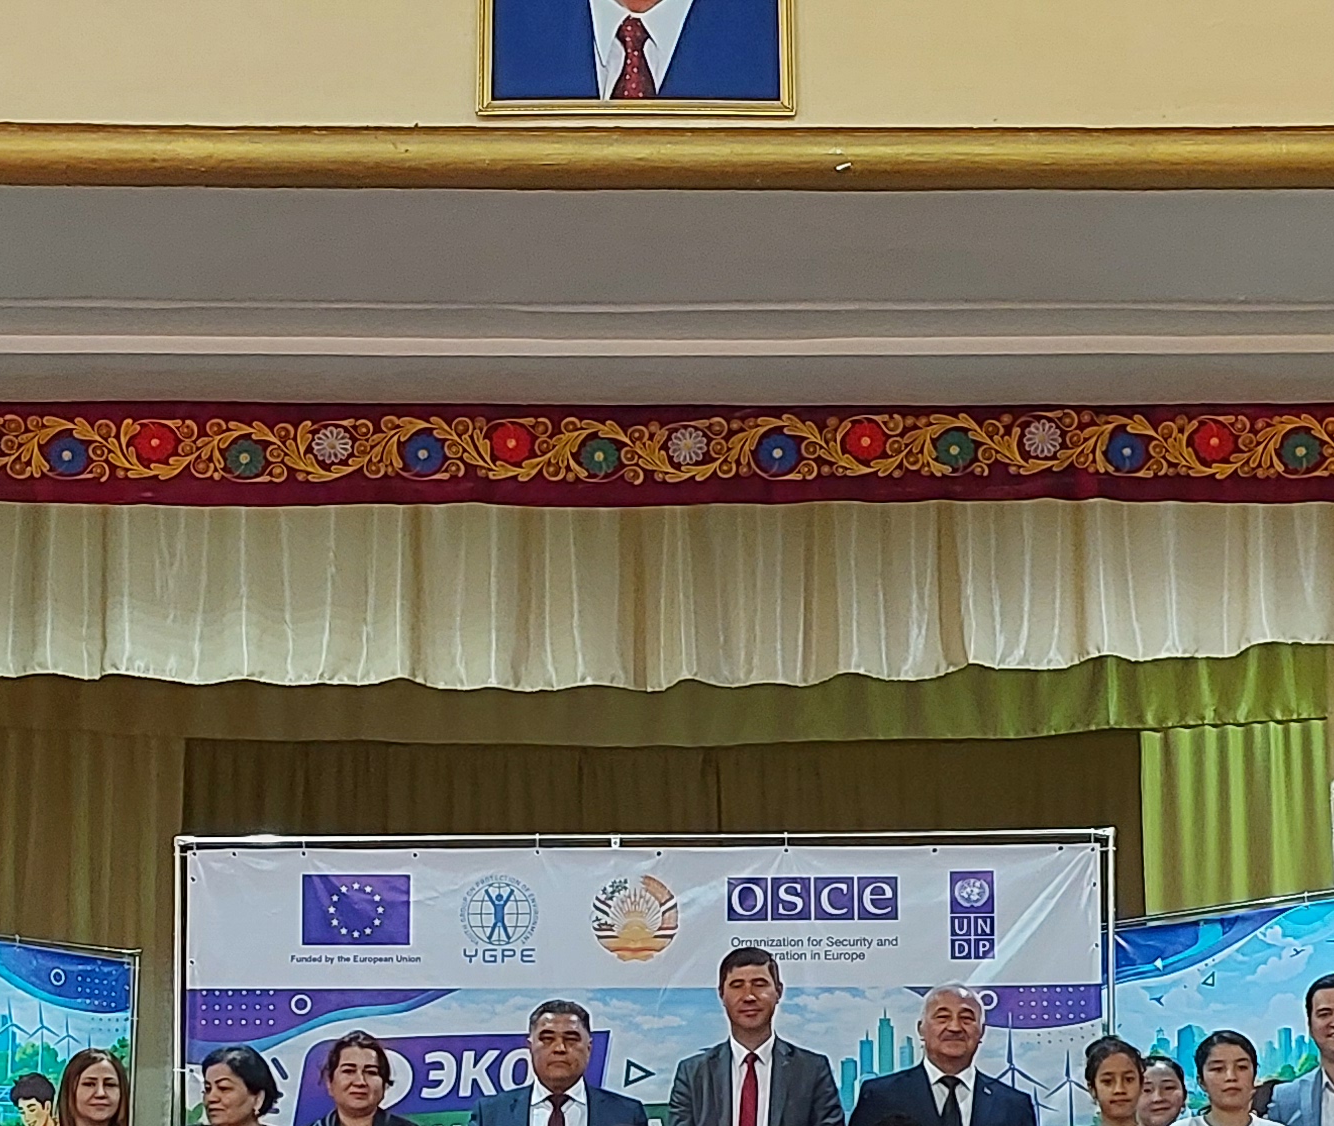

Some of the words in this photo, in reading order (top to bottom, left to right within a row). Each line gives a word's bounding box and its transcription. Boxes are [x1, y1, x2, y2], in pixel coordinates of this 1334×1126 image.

[731, 936, 804, 949] Organization
[807, 936, 823, 947] for
[826, 936, 873, 949] Security
[877, 936, 898, 947] and
[290, 955, 323, 963] Funded
[325, 955, 334, 965] by
[337, 955, 351, 963] the
[353, 955, 394, 965] European
[396, 955, 421, 963] Union
[463, 948, 536, 964] YGPE
[810, 950, 821, 961] in
[824, 950, 866, 963] Europe
[420, 1048, 534, 1098] ЭКО
